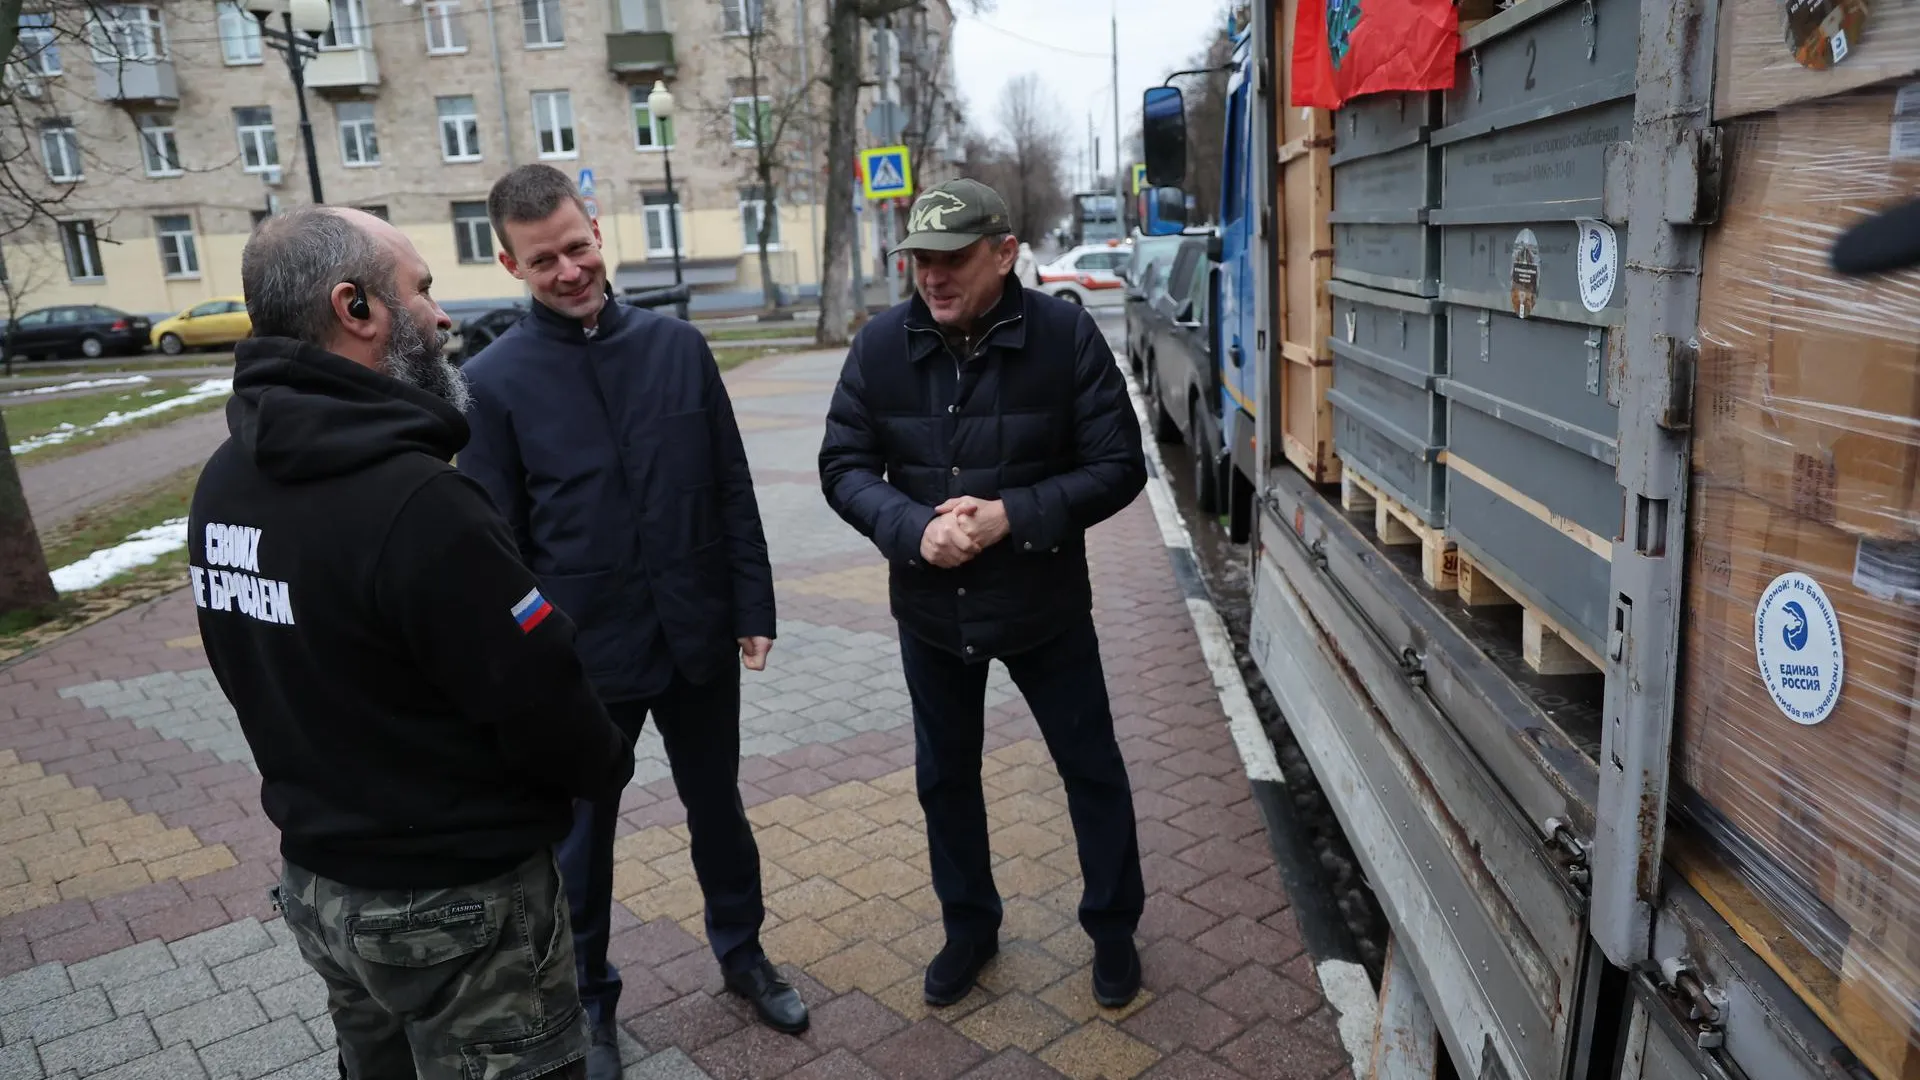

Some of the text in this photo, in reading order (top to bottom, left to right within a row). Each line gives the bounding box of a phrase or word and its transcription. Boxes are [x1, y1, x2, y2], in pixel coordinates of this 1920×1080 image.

[1524, 38, 1537, 91] 2
[205, 522, 262, 573] СВОИХ
[207, 568, 296, 625] БРОСАЕМ
[1794, 579, 1805, 591] Из
[1806, 586, 1837, 646] Балашихи
[1779, 663, 1819, 677] ЕДИНАЯ
[1781, 676, 1821, 692] РОССИЯ
